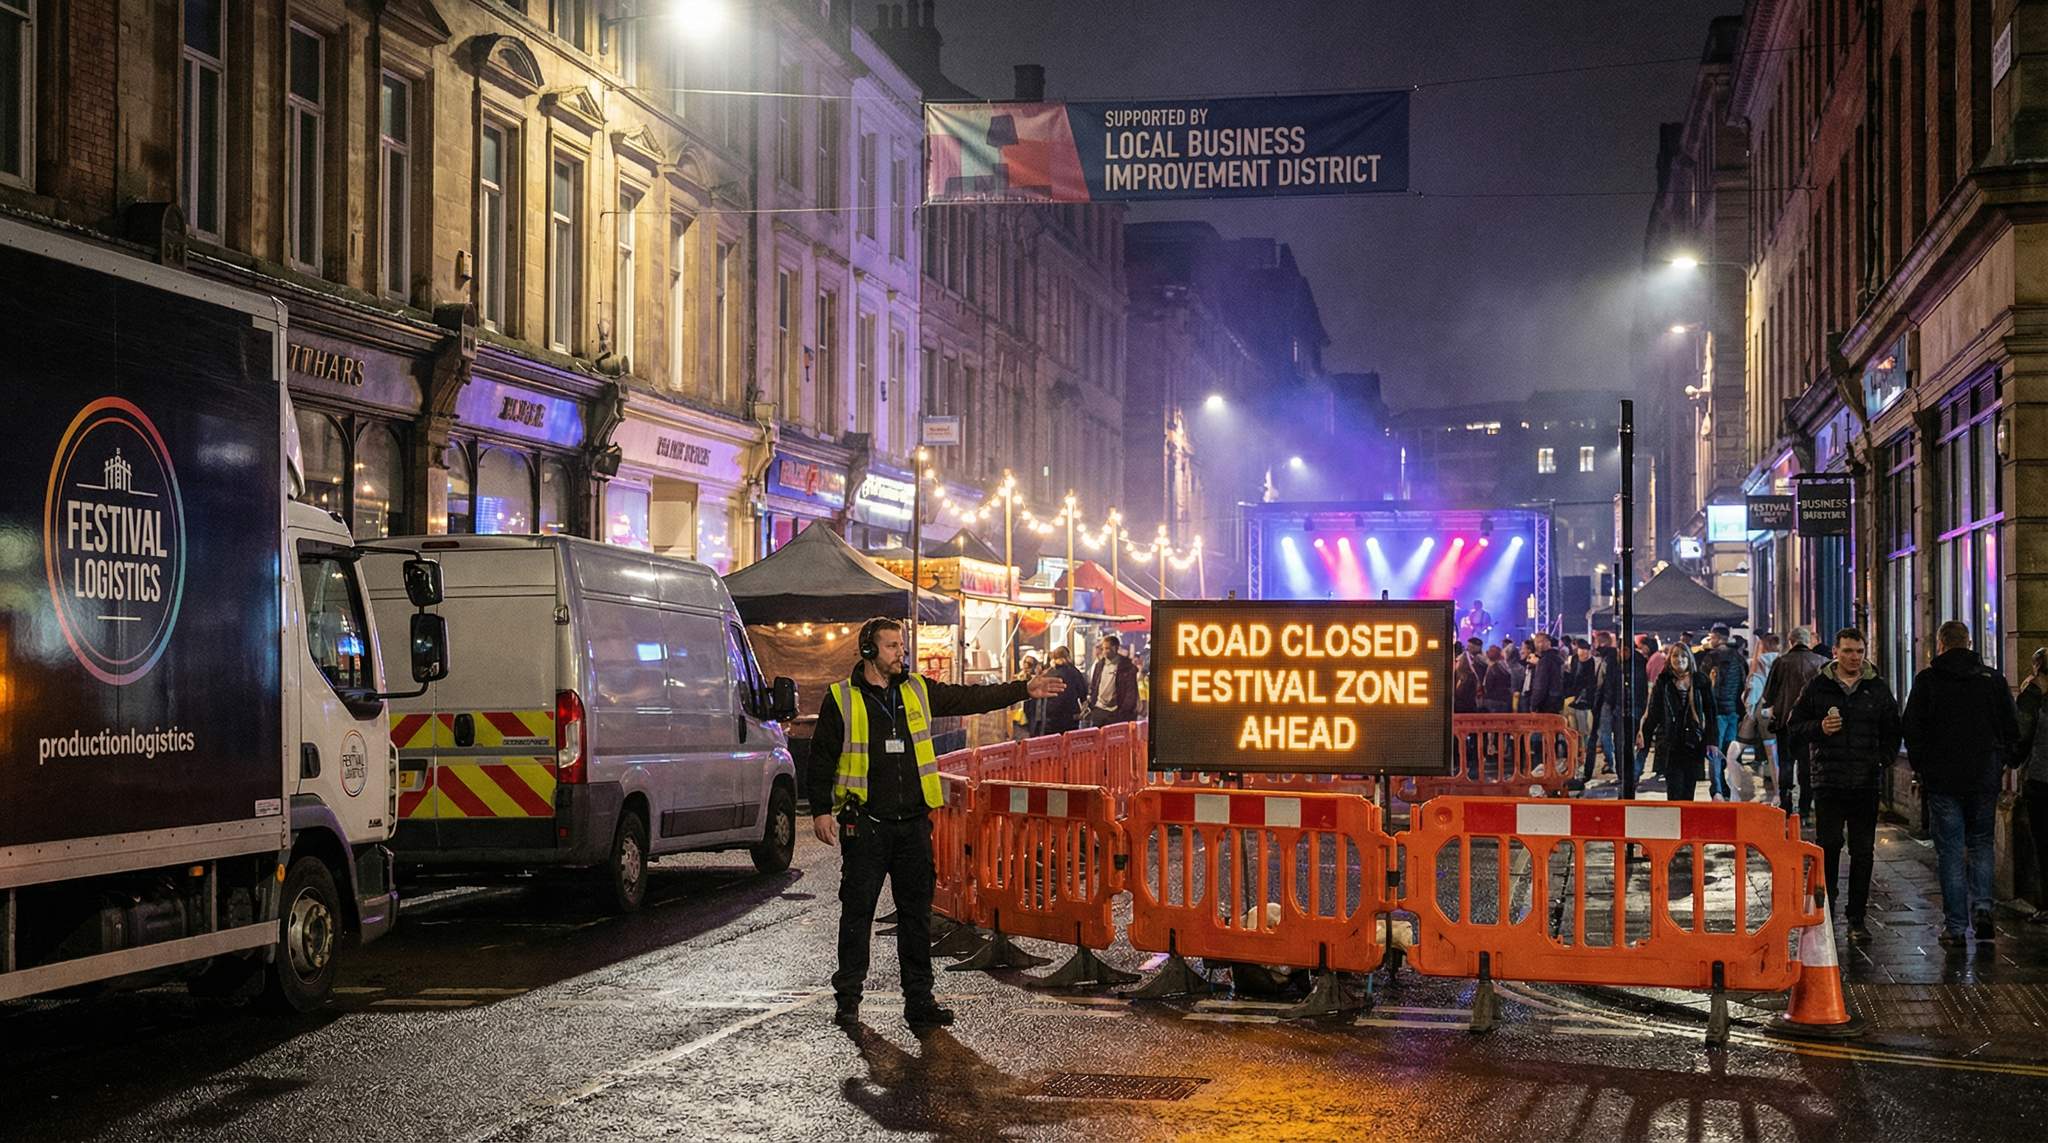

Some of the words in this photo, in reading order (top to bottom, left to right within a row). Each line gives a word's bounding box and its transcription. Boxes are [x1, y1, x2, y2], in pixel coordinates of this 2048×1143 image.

[1104, 109, 1185, 128] SUPPORTED
[1190, 108, 1208, 125] BY
[1105, 130, 1180, 159] LOCAL
[1188, 126, 1306, 157] BUSINESS
[1105, 159, 1271, 191] IMPROVEMENT
[1278, 154, 1382, 186] DISTRICT
[67, 499, 168, 557] FESTIVAL
[74, 557, 161, 602] LOGISTICS
[1177, 623, 1272, 657] ROAD
[1281, 623, 1420, 657] CLOSED
[1171, 669, 1327, 703] FESTIVAL
[1335, 670, 1429, 704] ZONE
[39, 725, 195, 766] productionlogistics
[1238, 716, 1358, 749] AHEAD
